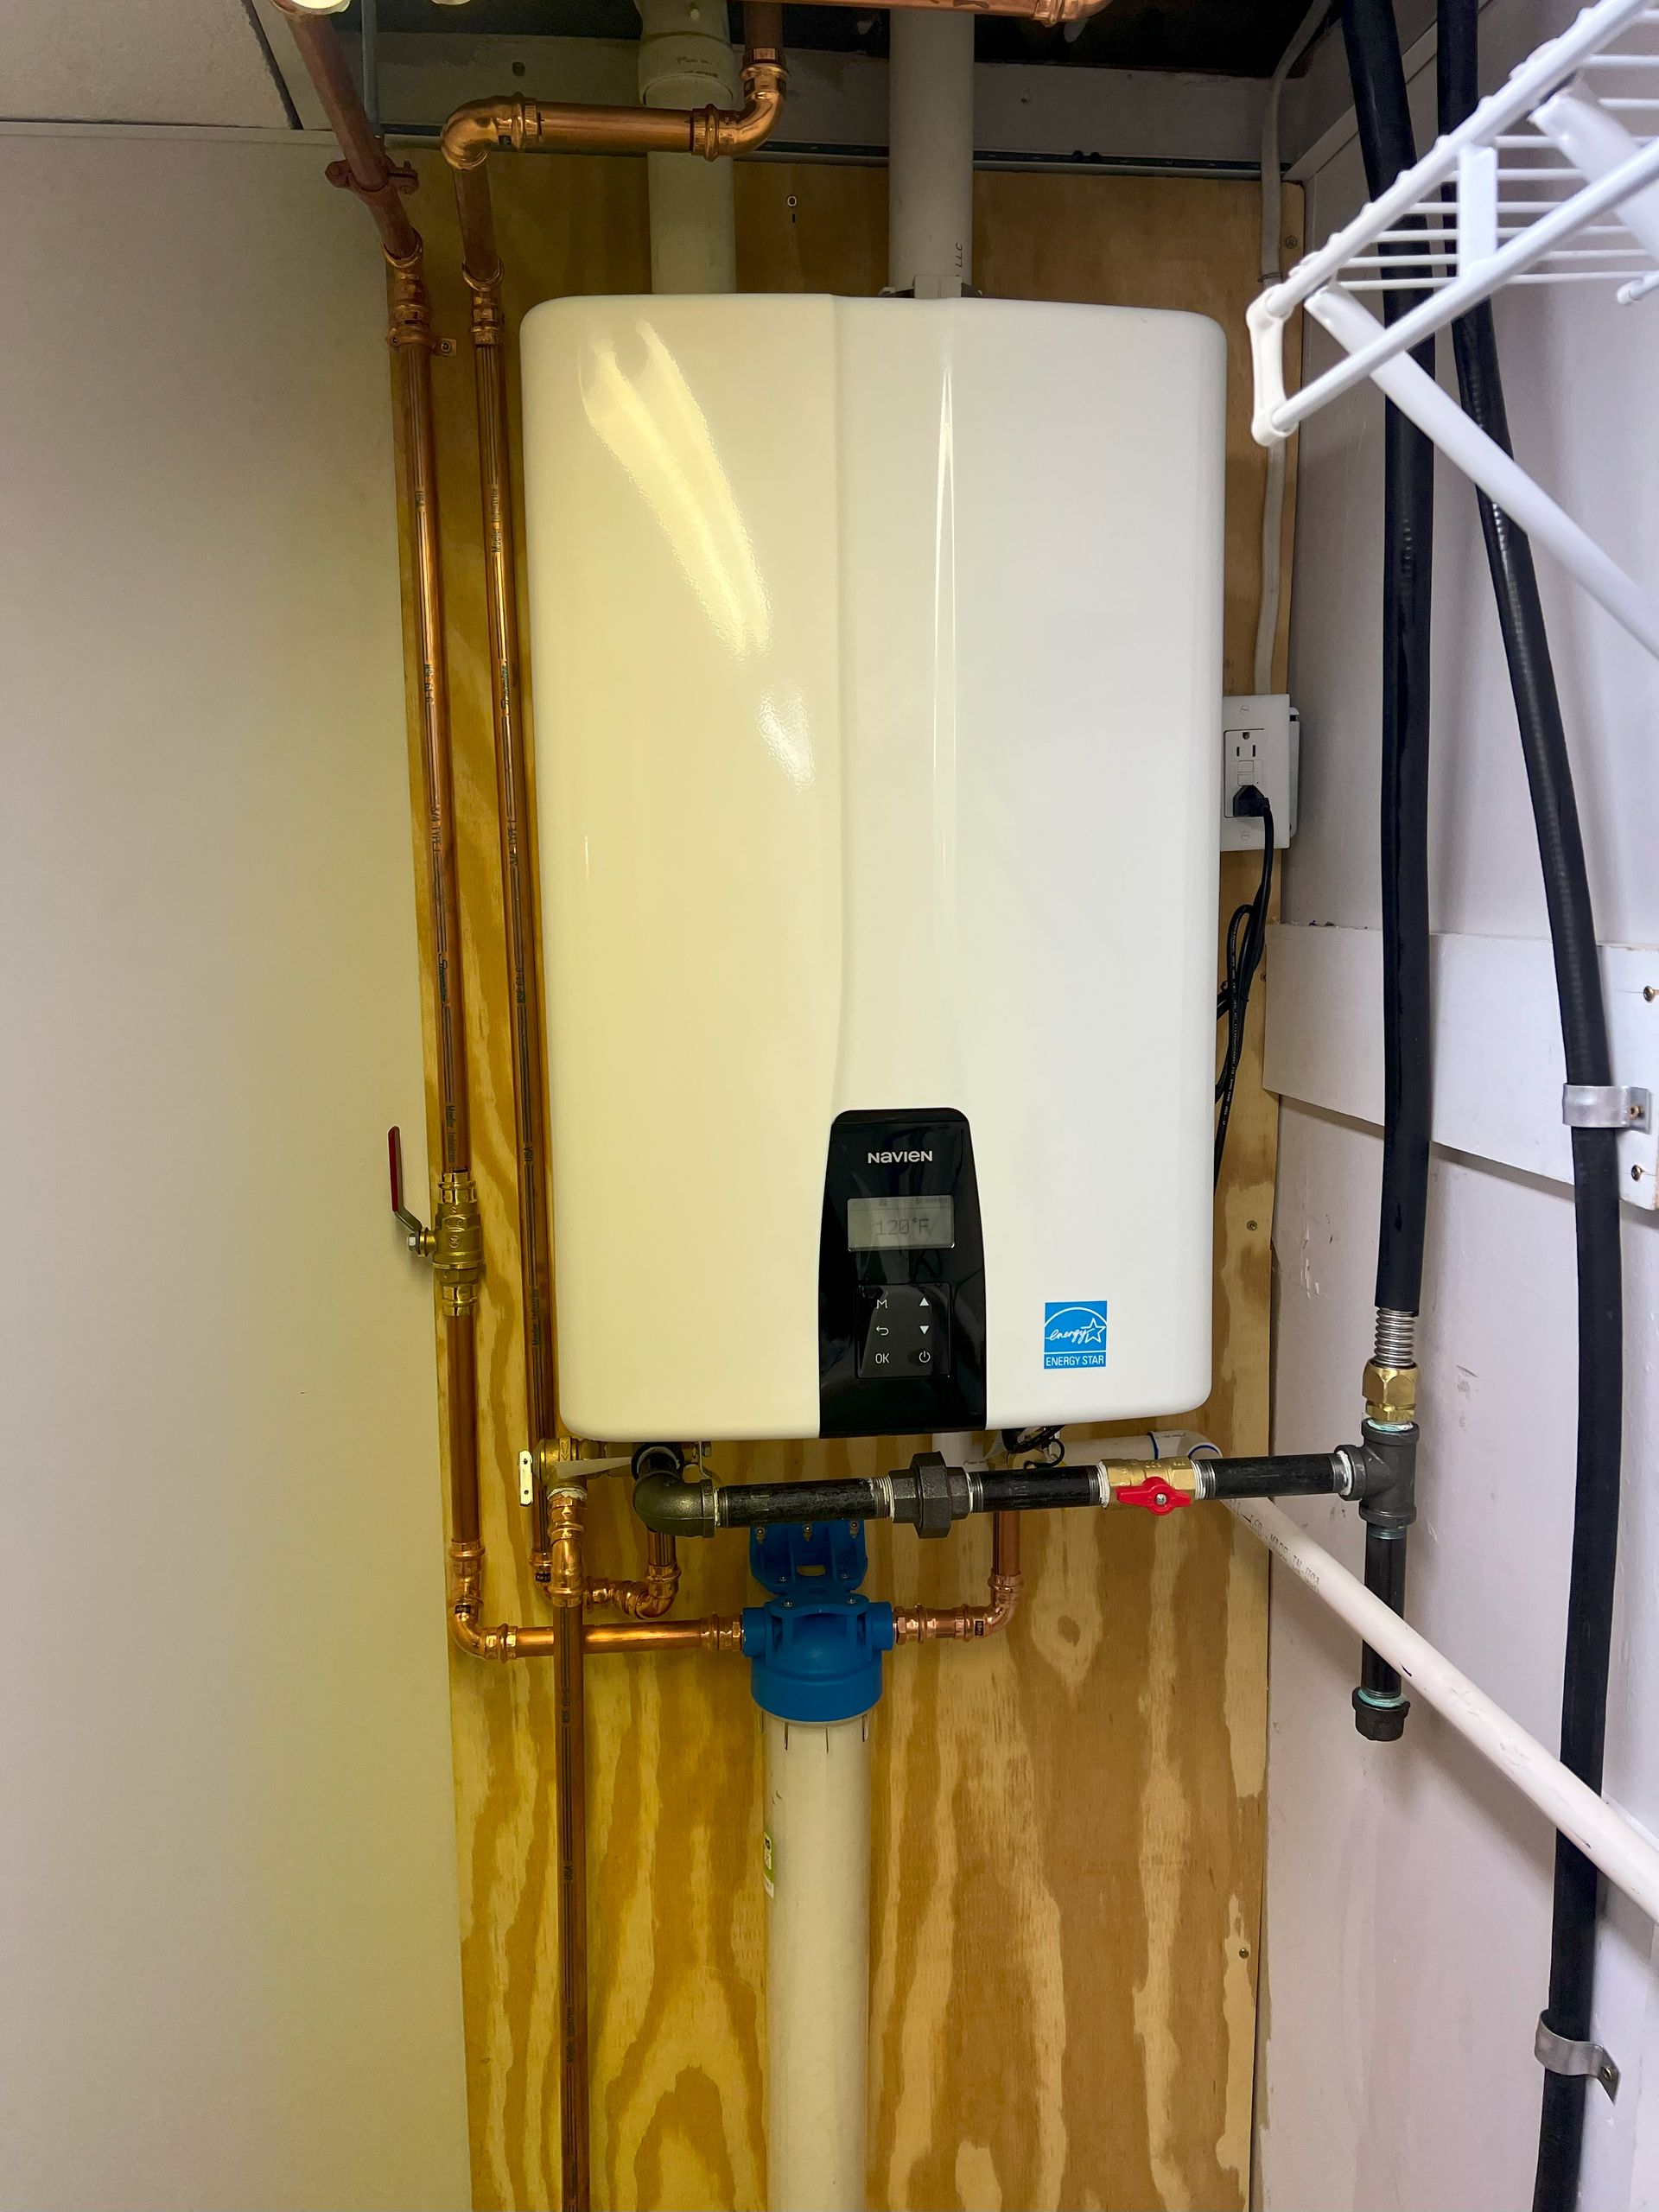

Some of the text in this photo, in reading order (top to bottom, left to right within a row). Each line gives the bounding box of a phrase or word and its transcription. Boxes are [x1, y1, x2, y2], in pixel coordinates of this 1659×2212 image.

[876, 1299, 888, 1309] M
[875, 1352, 890, 1364] OK
[1046, 1354, 1104, 1367] ENERGY STAR
